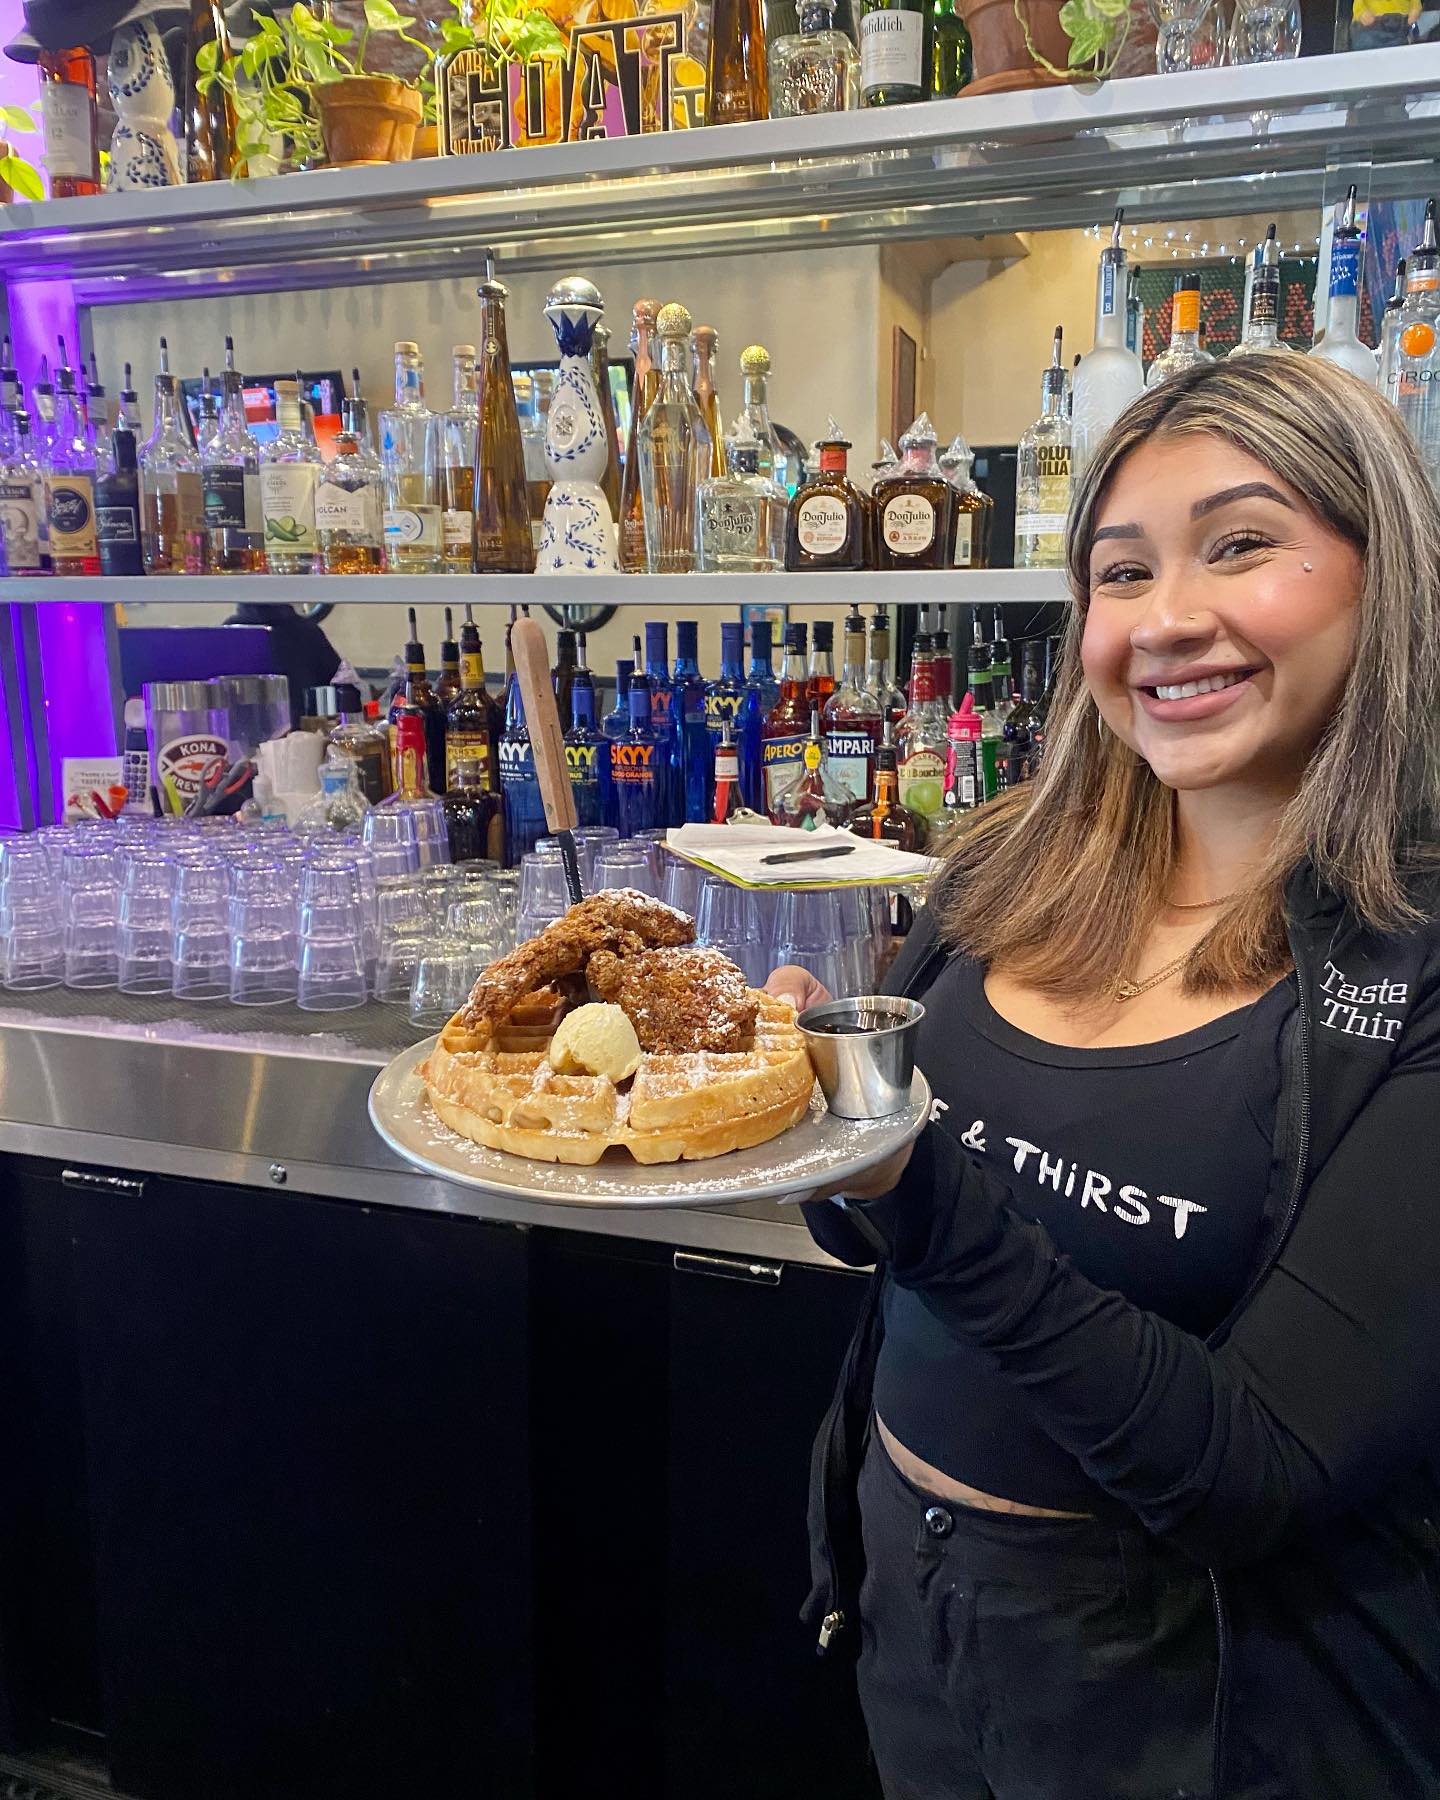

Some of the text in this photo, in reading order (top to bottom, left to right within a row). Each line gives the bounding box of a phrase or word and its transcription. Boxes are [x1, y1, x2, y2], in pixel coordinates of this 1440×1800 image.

[864, 16, 903, 37] nfiddich
[650, 692, 673, 711] YY
[179, 742, 217, 756] KONA
[498, 742, 530, 762] KYY
[564, 746, 597, 766] KYY
[610, 744, 655, 766] SKYY
[764, 742, 803, 762] APERO
[828, 739, 875, 754] AMPARI
[1319, 960, 1408, 1004] Taste
[1319, 998, 1403, 1042] Thir
[960, 1119, 986, 1152] &
